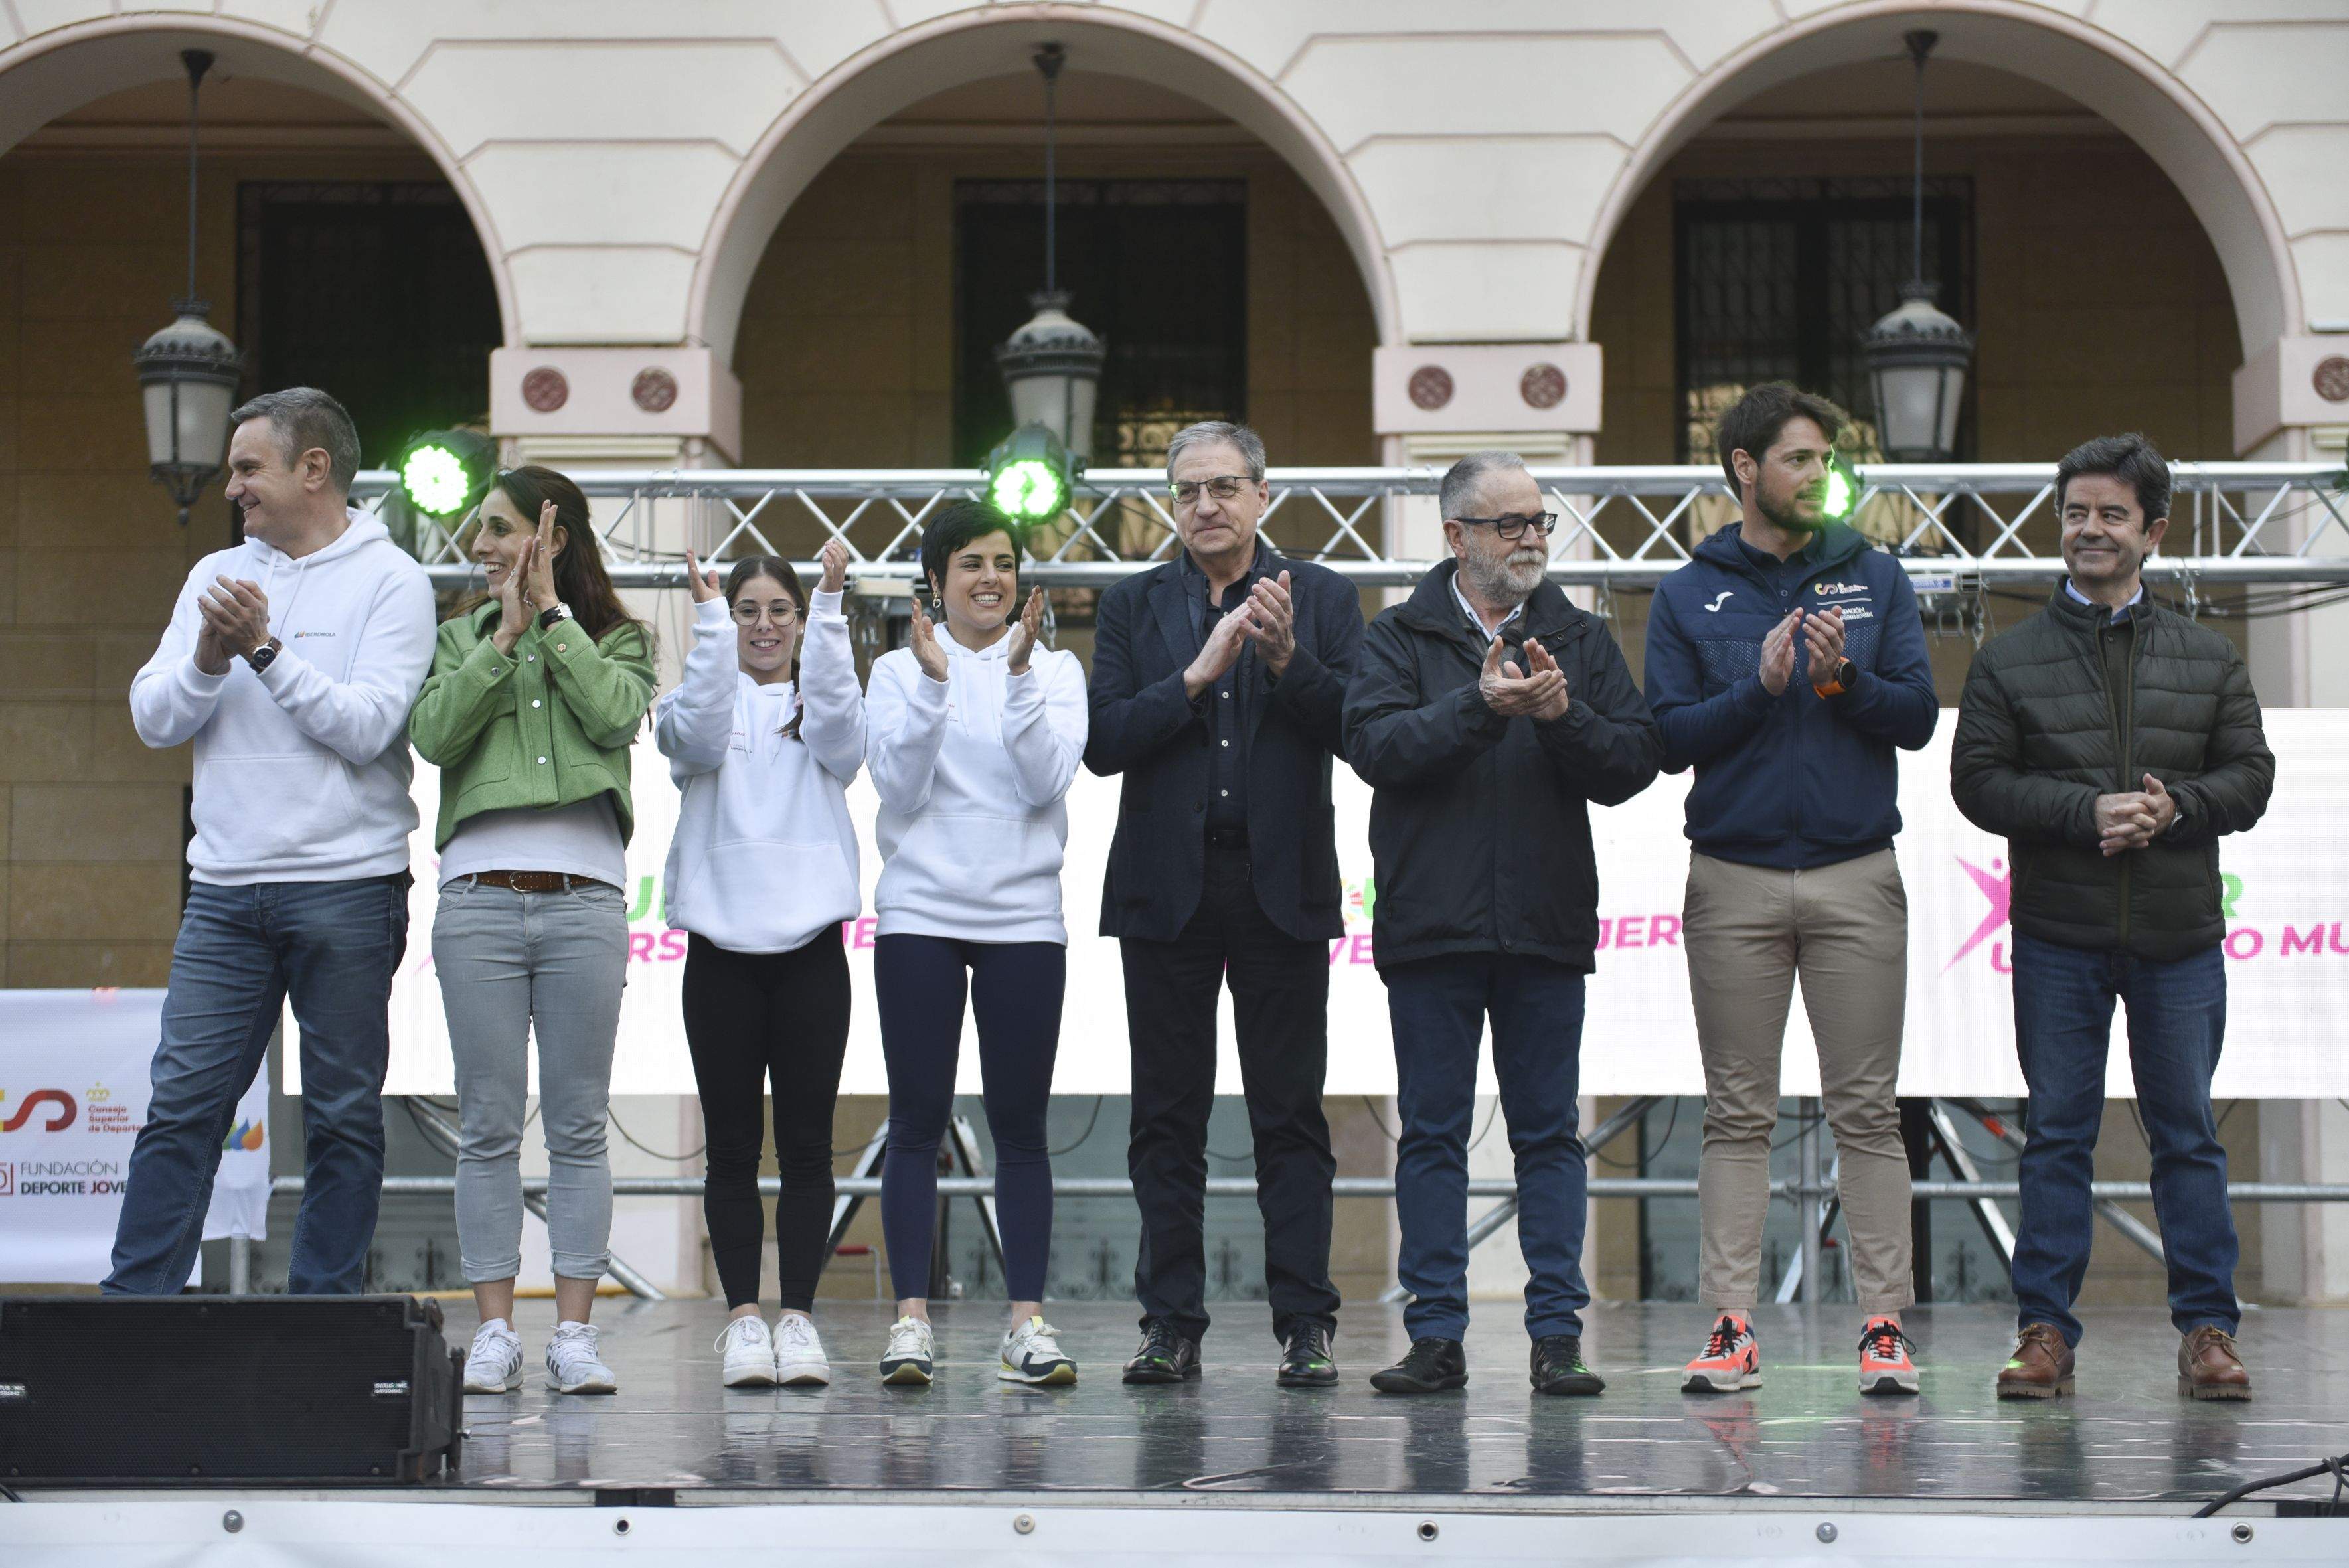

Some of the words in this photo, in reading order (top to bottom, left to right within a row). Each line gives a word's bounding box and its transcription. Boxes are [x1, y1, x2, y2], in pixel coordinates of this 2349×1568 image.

[88, 1104, 127, 1114] Consejo
[89, 1114, 129, 1123] Superior
[103, 1125, 142, 1133] Deporte
[20, 1159, 118, 1176] FUNDACIÓN
[21, 1180, 86, 1194] DEPORTE
[90, 1180, 127, 1195] JOVE
